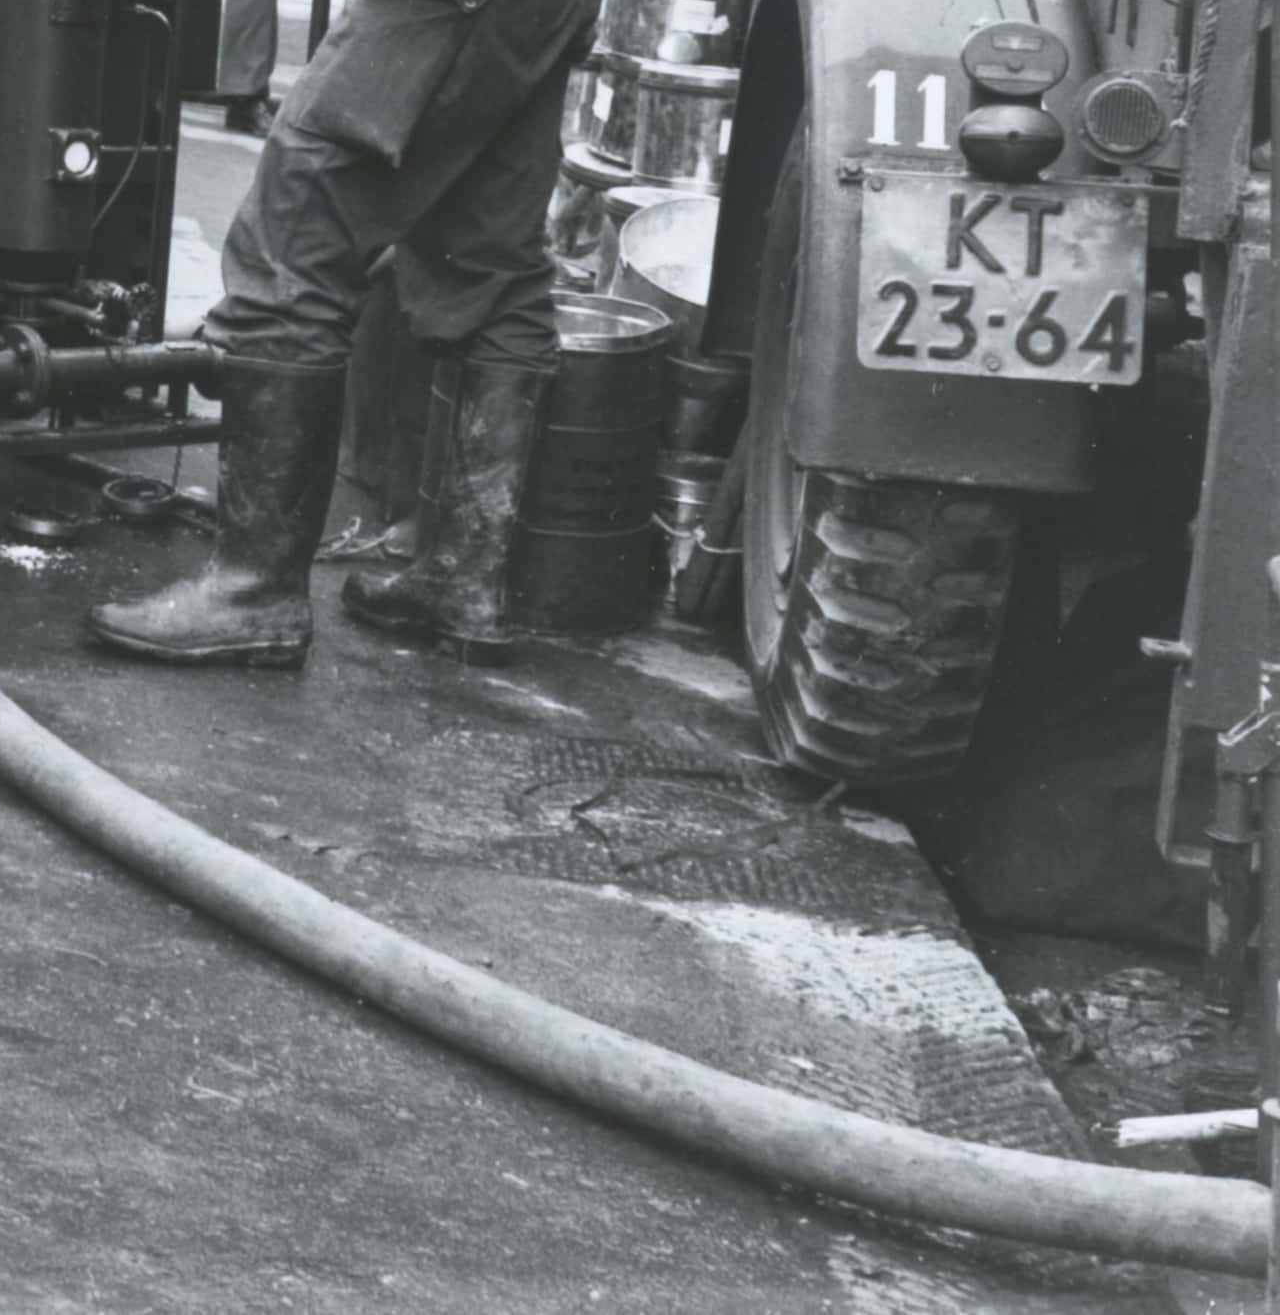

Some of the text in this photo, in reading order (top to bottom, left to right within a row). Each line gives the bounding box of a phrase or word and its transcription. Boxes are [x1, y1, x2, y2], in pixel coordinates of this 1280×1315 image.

[867, 69, 951, 150] 11
[945, 192, 1064, 277] KT
[874, 280, 1135, 372] 23-64
